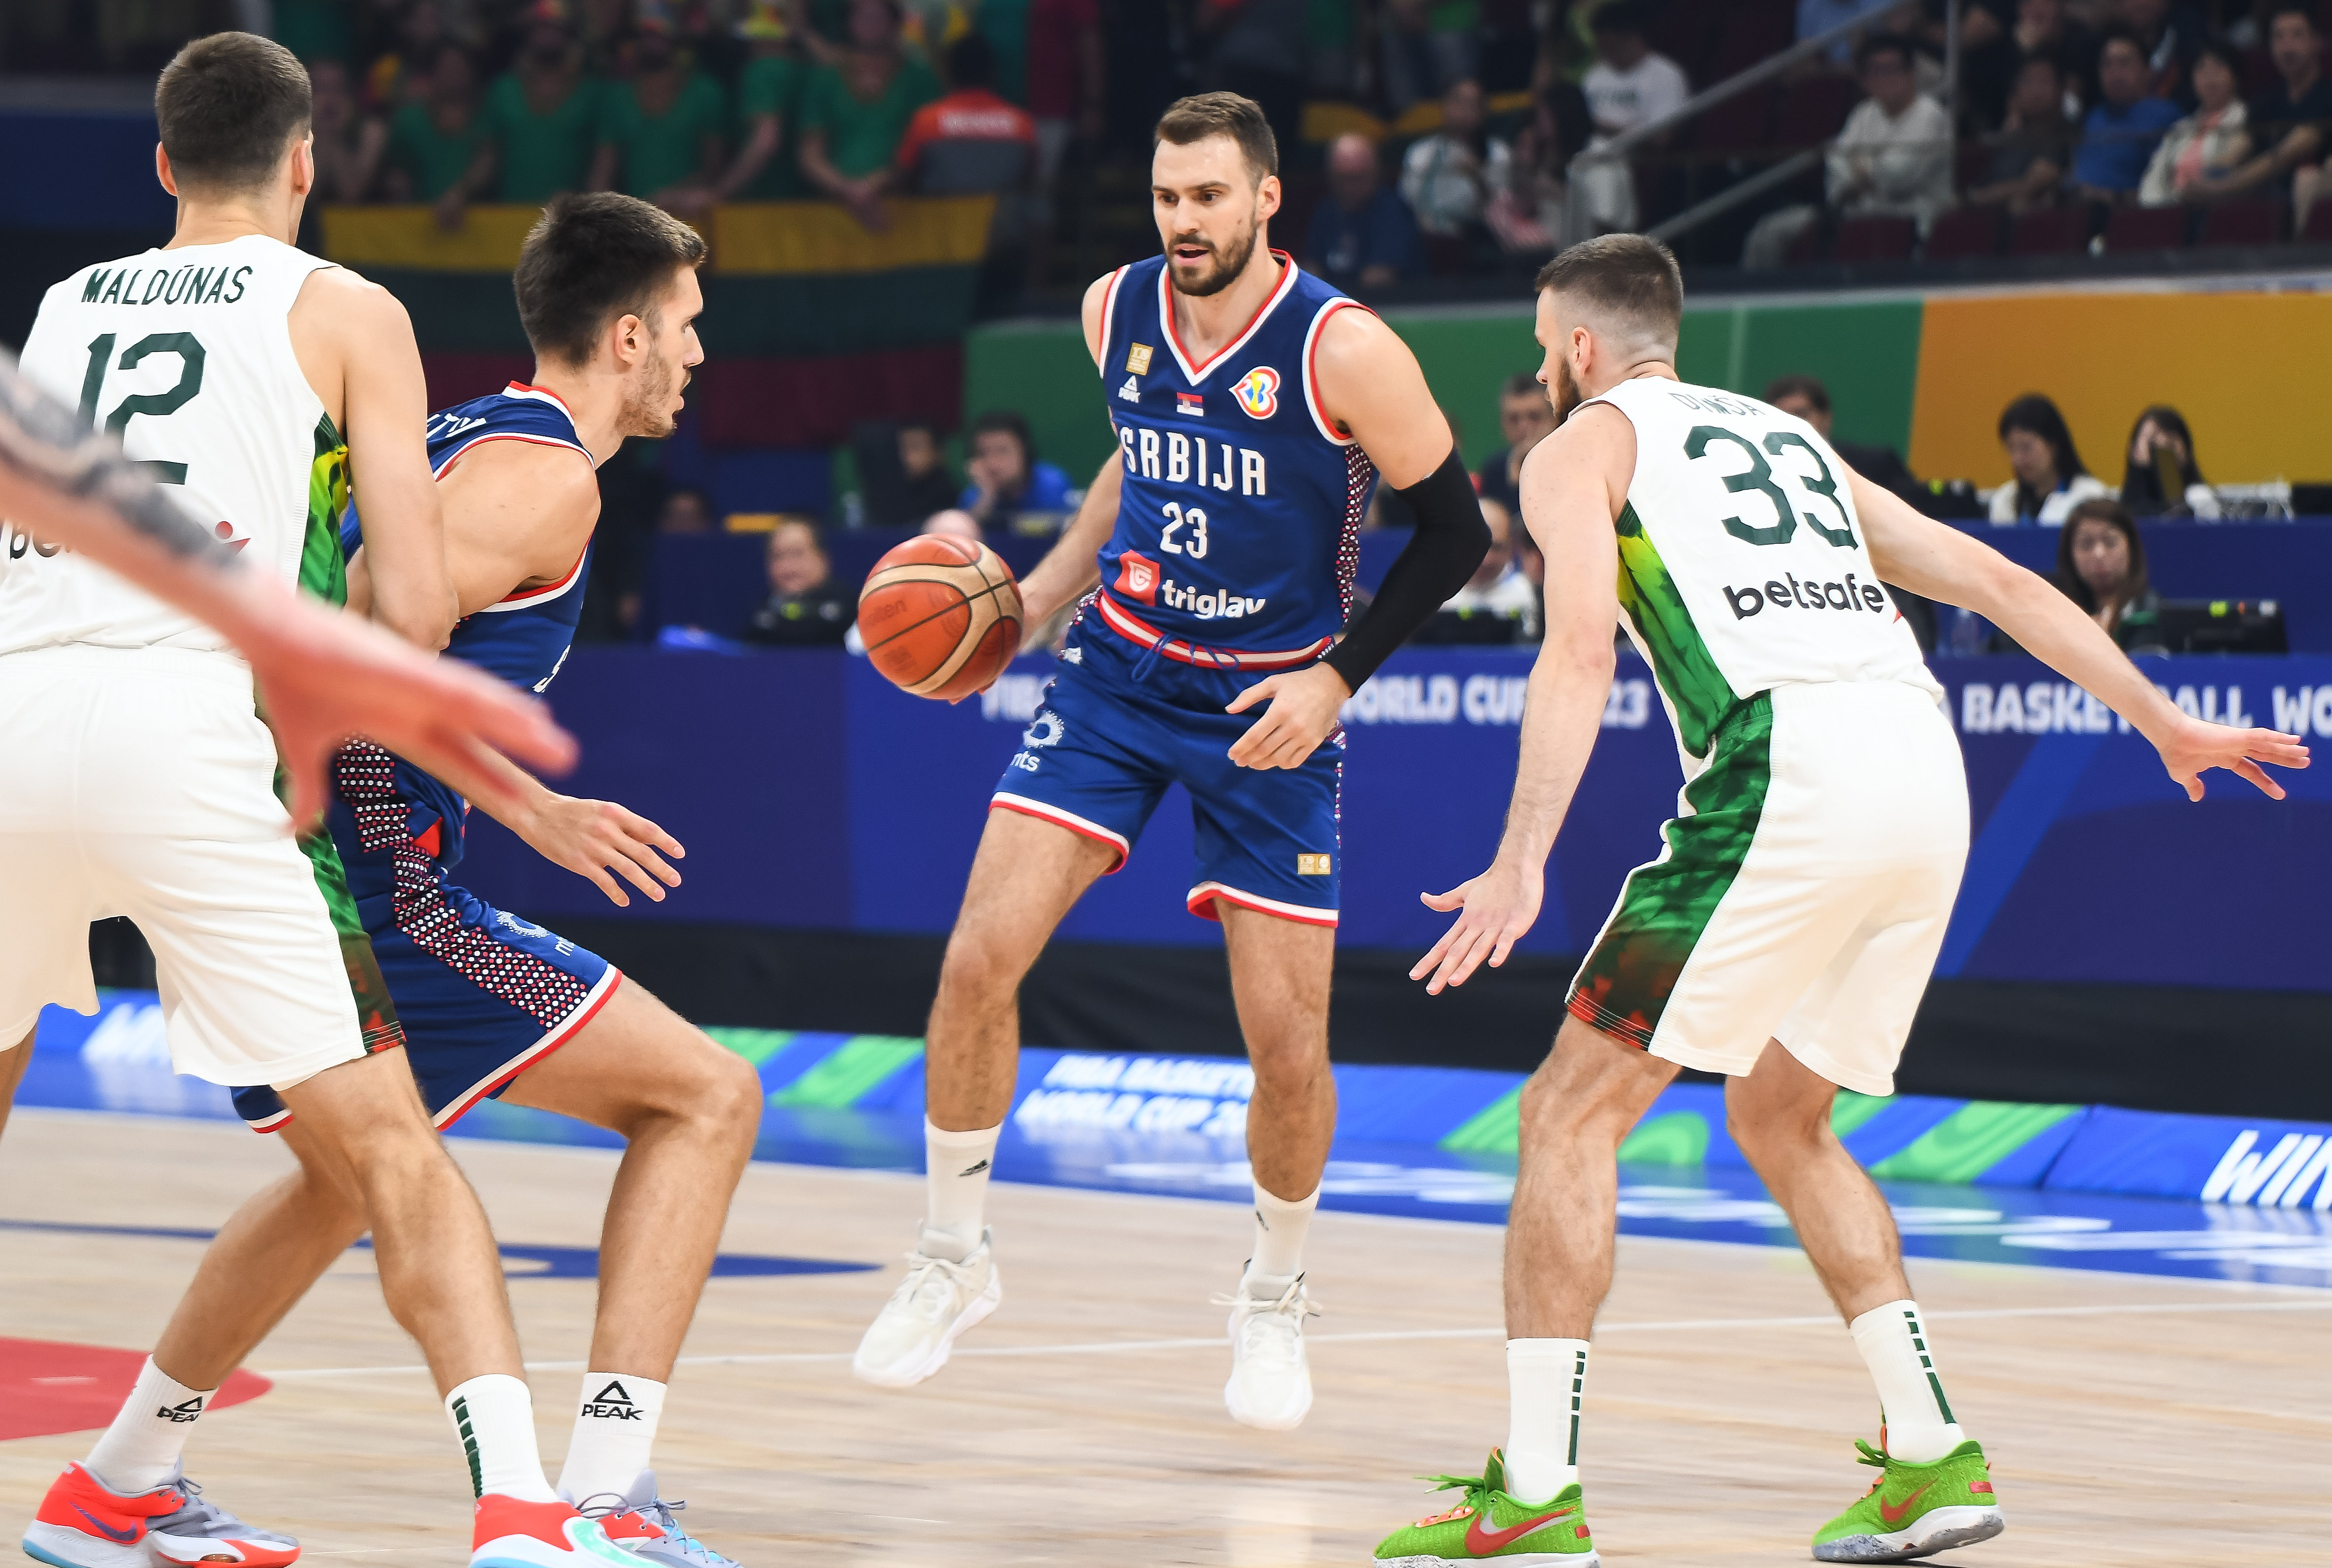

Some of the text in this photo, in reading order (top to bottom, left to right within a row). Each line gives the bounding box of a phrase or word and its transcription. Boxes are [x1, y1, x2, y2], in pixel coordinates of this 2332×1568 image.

[81, 264, 253, 305] MALDŪNAS
[77, 332, 206, 485] 12
[1120, 426, 1266, 496] SRBIJA
[1683, 425, 1859, 551] 33
[1160, 500, 1208, 559] 23
[1161, 578, 1267, 620] triglav
[1722, 572, 1885, 621] betsafe
[581, 1404, 645, 1420] PEAK
